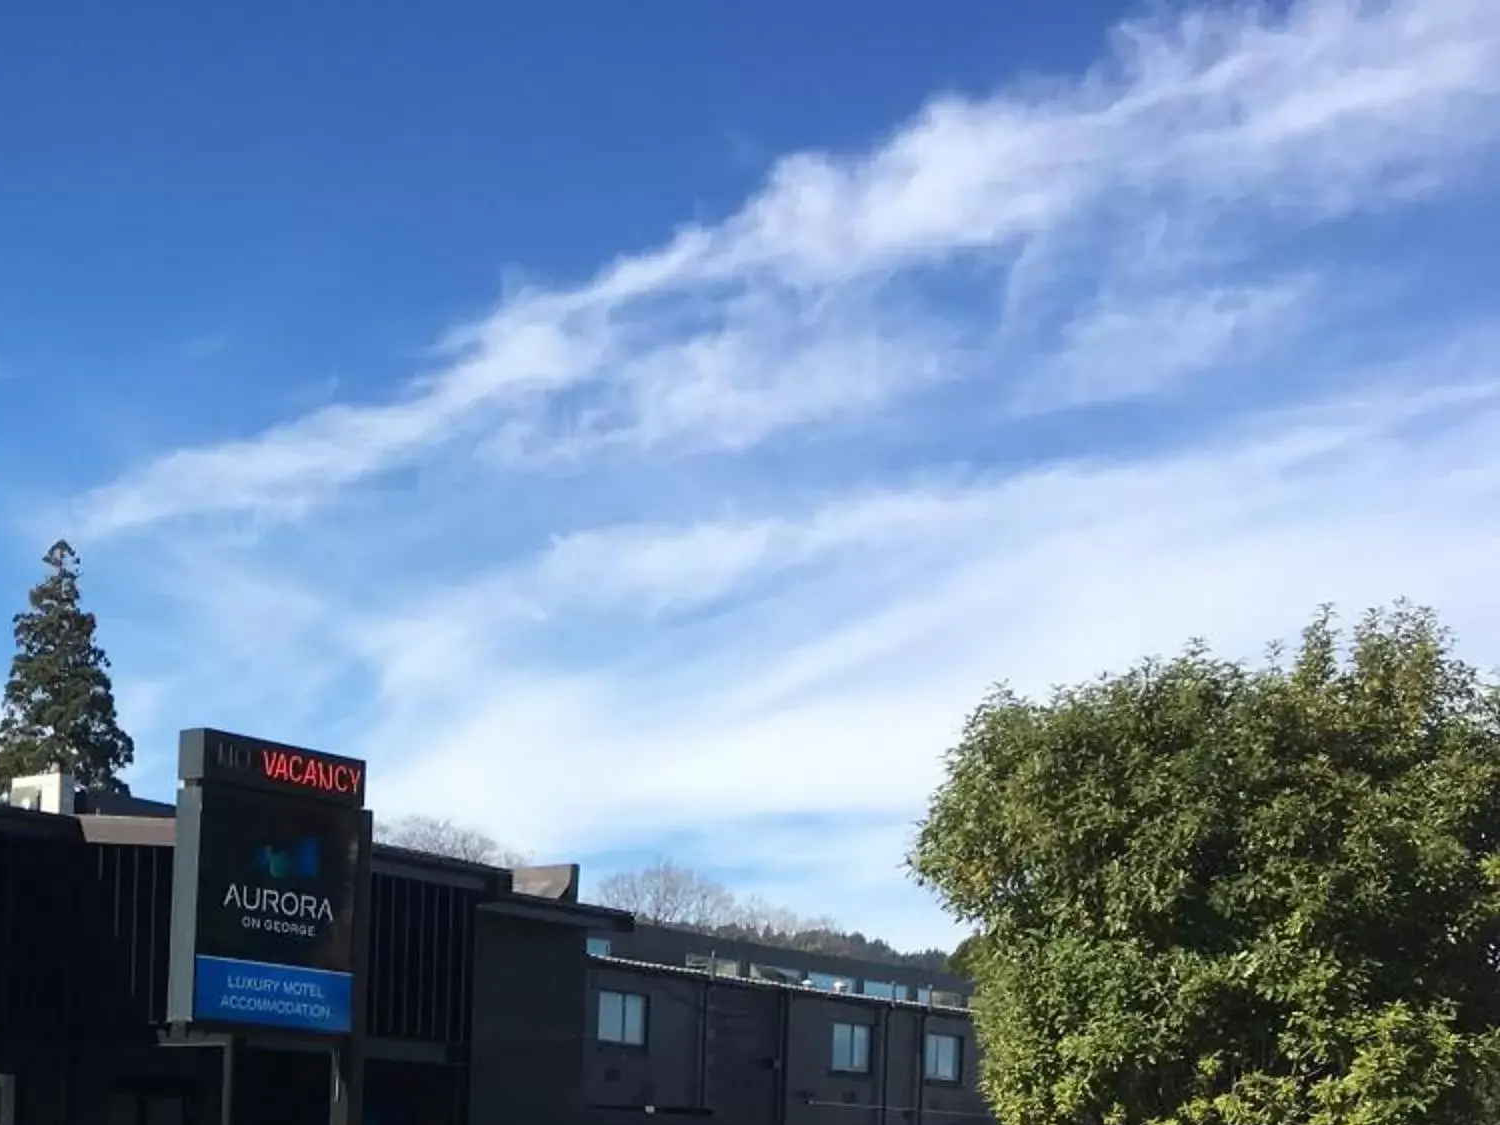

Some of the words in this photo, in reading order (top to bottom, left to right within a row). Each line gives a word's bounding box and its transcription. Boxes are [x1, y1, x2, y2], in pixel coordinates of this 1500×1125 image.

[263, 751, 361, 794] VACANCY
[223, 883, 333, 922] AURORA
[241, 916, 261, 929] ON
[264, 919, 317, 937] GEORGE
[227, 974, 280, 993] LUXURY
[283, 979, 325, 999] MOTEL
[220, 994, 332, 1019] ACCOMMODATION
